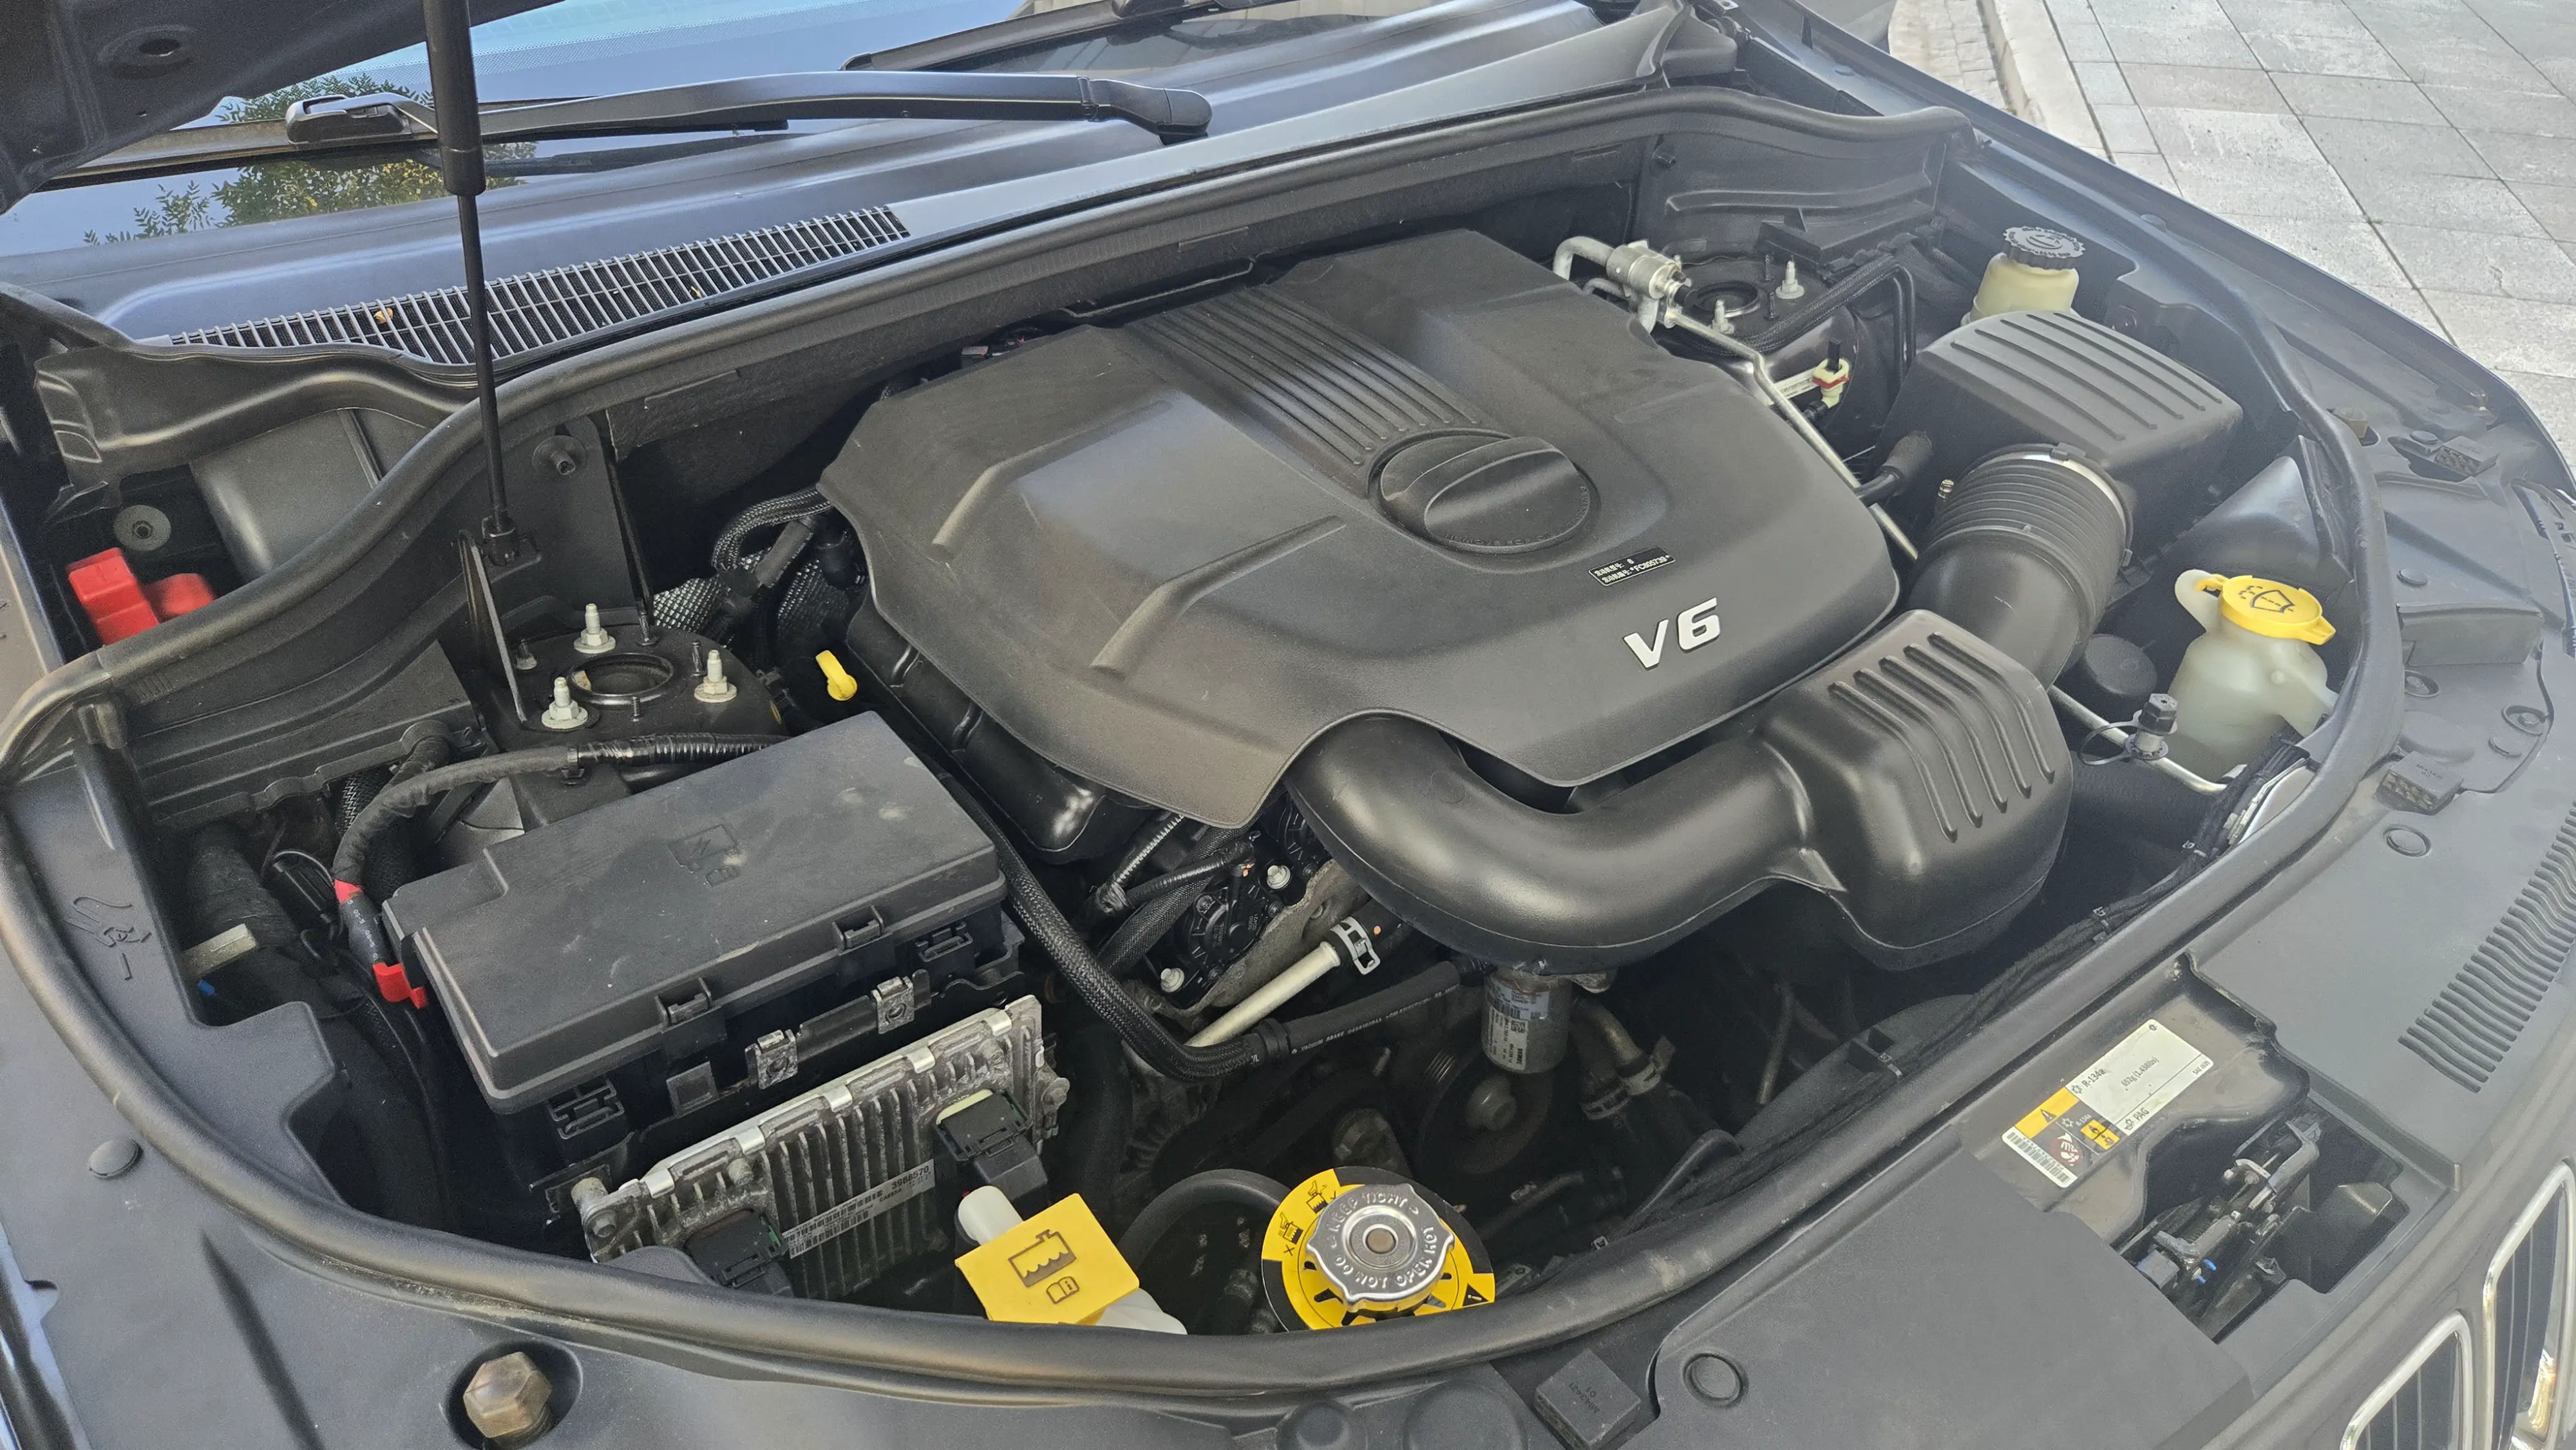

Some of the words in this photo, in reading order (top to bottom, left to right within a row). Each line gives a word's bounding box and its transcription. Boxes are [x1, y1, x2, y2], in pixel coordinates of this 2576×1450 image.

[1622, 598, 1720, 670] V6
[2082, 1068, 2105, 1088] R-134a
[2134, 1107, 2150, 1122] PAG
[1327, 1198, 1358, 1232] KEEP
[1335, 1254, 1353, 1274] DO
[1355, 1272, 1388, 1288] NOT
[1396, 1257, 1432, 1286] OPEN
[1421, 1225, 1437, 1254] HOT
